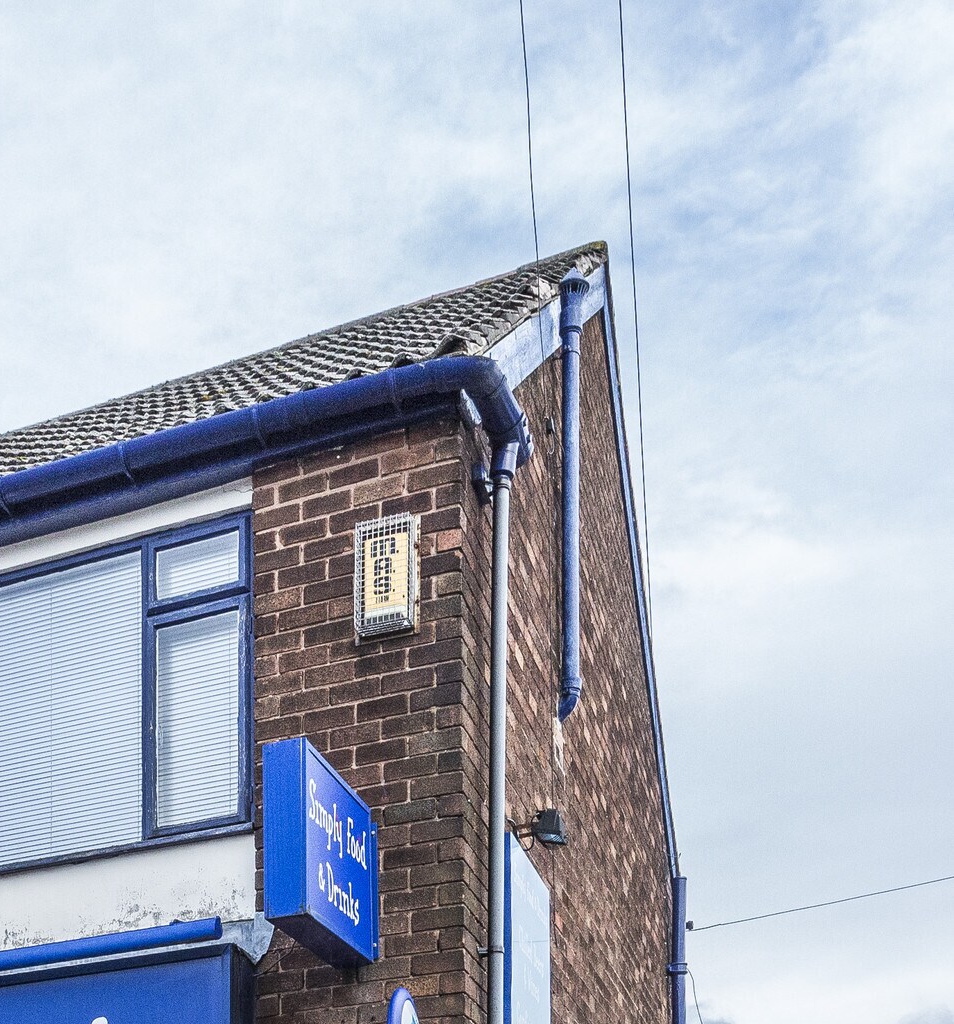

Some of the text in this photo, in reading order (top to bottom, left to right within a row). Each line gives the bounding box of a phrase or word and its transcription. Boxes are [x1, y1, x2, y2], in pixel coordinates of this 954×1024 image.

[309, 778, 367, 870] Simply Food
[318, 862, 360, 925] & Drinks
